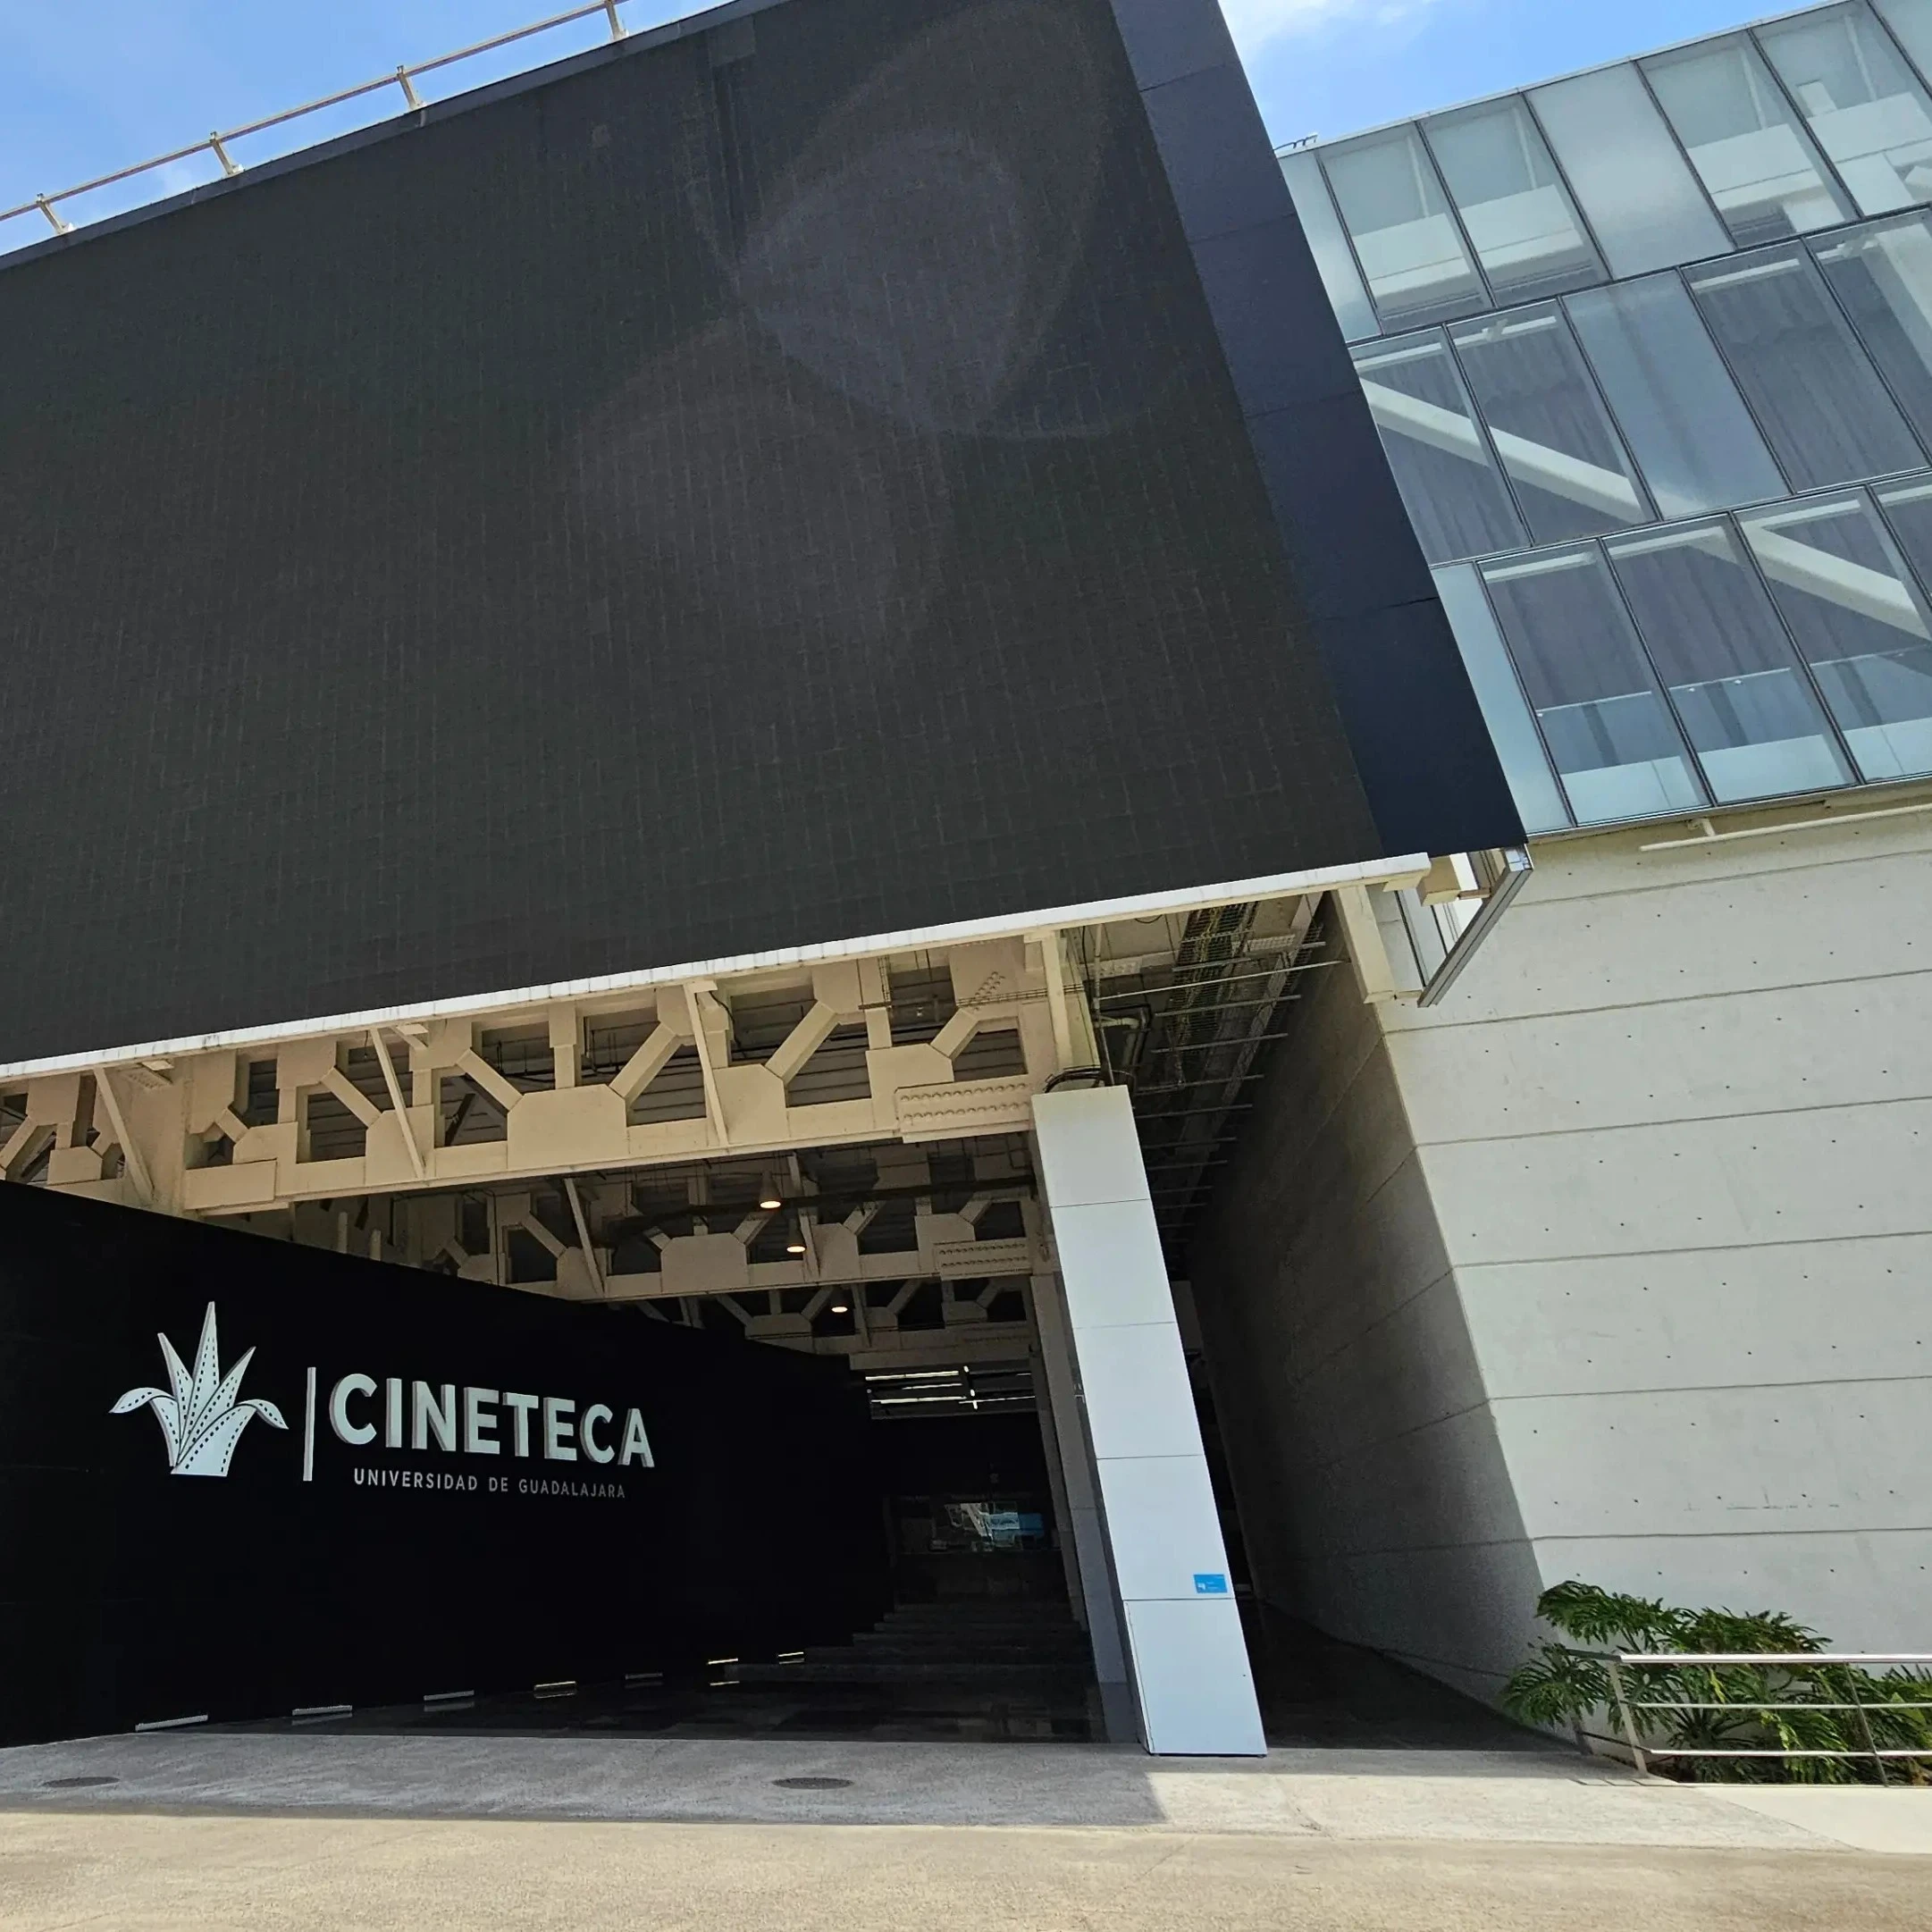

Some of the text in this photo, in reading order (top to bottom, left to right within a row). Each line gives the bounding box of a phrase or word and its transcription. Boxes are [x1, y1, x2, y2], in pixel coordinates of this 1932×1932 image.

[329, 1373, 655, 1467] CINETECA
[353, 1467, 626, 1499] UNIVERSIDAD DE GUADALAJARA
